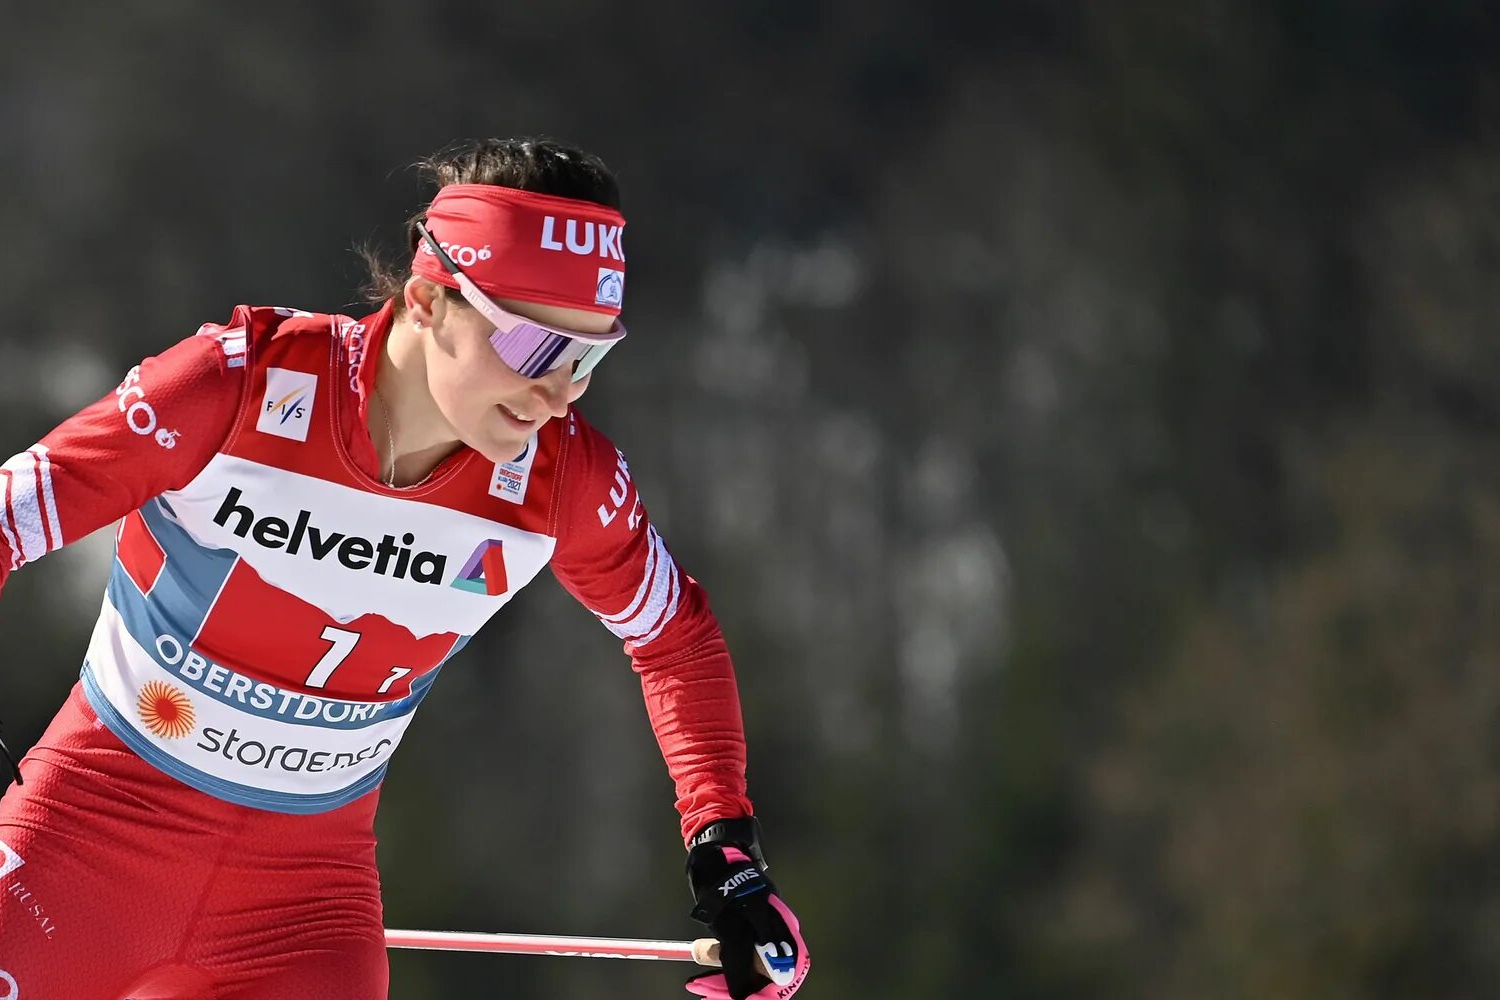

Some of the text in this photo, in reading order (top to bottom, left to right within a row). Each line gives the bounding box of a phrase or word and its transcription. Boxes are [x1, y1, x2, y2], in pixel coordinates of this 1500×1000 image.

[212, 486, 447, 587] helvetia
[156, 633, 386, 723] OBERSTDORF
[8, 881, 58, 941] RUSAL
